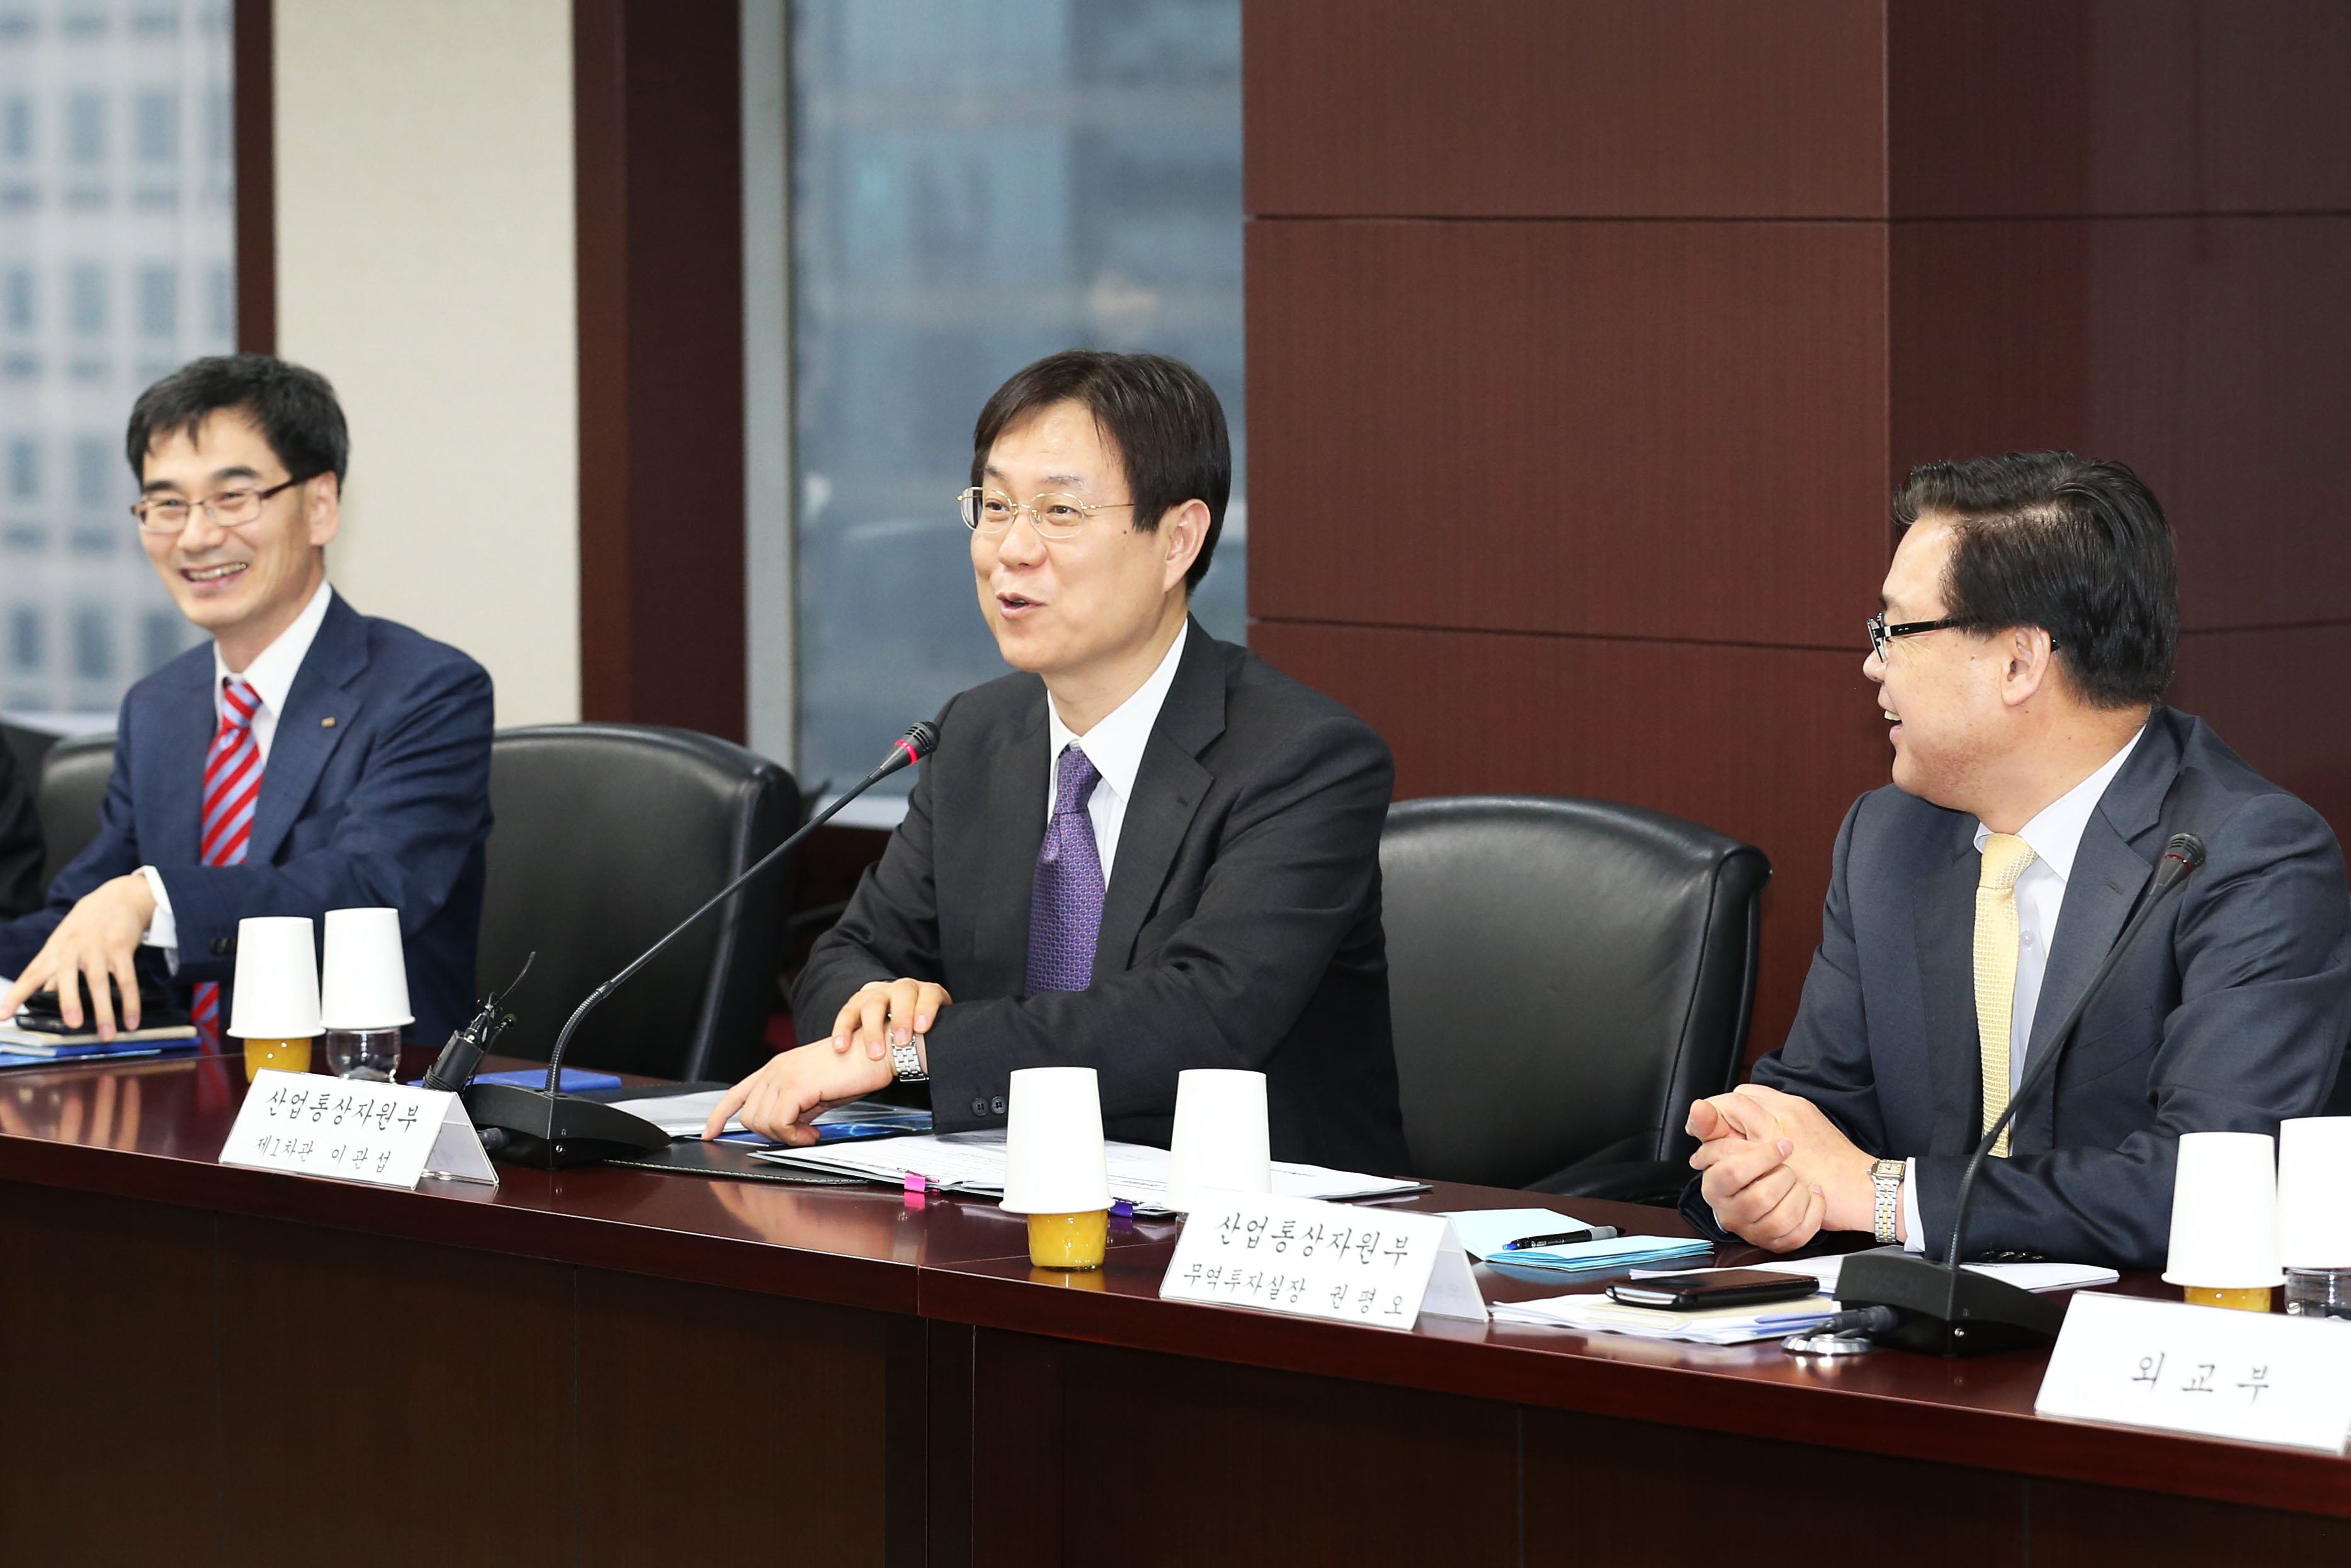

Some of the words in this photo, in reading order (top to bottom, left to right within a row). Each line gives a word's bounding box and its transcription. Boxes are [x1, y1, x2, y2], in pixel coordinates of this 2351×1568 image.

[267, 1087, 419, 1132] 산업통상자원부
[255, 1135, 314, 1162] 제1차관
[1217, 1212, 1408, 1267] 산업통상자원부
[1183, 1263, 1306, 1303] 무역투자실장
